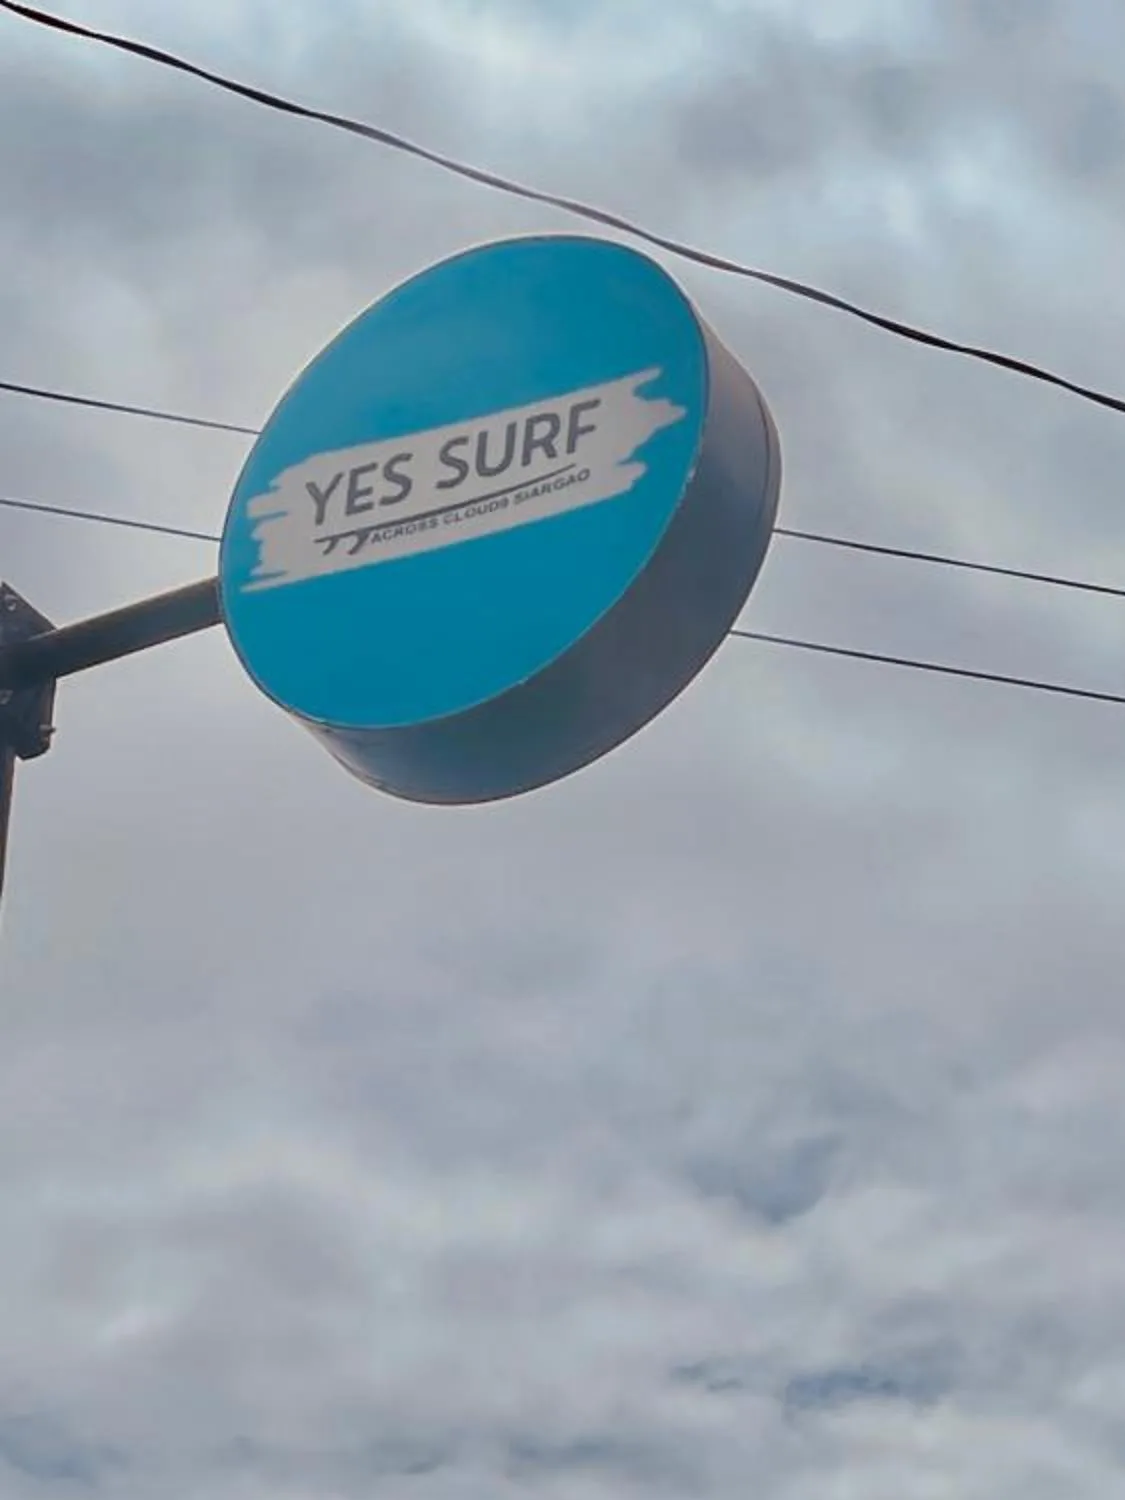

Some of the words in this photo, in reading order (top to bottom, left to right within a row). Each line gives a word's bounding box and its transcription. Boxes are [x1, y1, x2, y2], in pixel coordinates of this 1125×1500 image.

[305, 452, 413, 526] YES
[435, 398, 601, 489] SURF
[370, 517, 439, 544] ACROSS
[513, 468, 591, 505] SIARGAO
